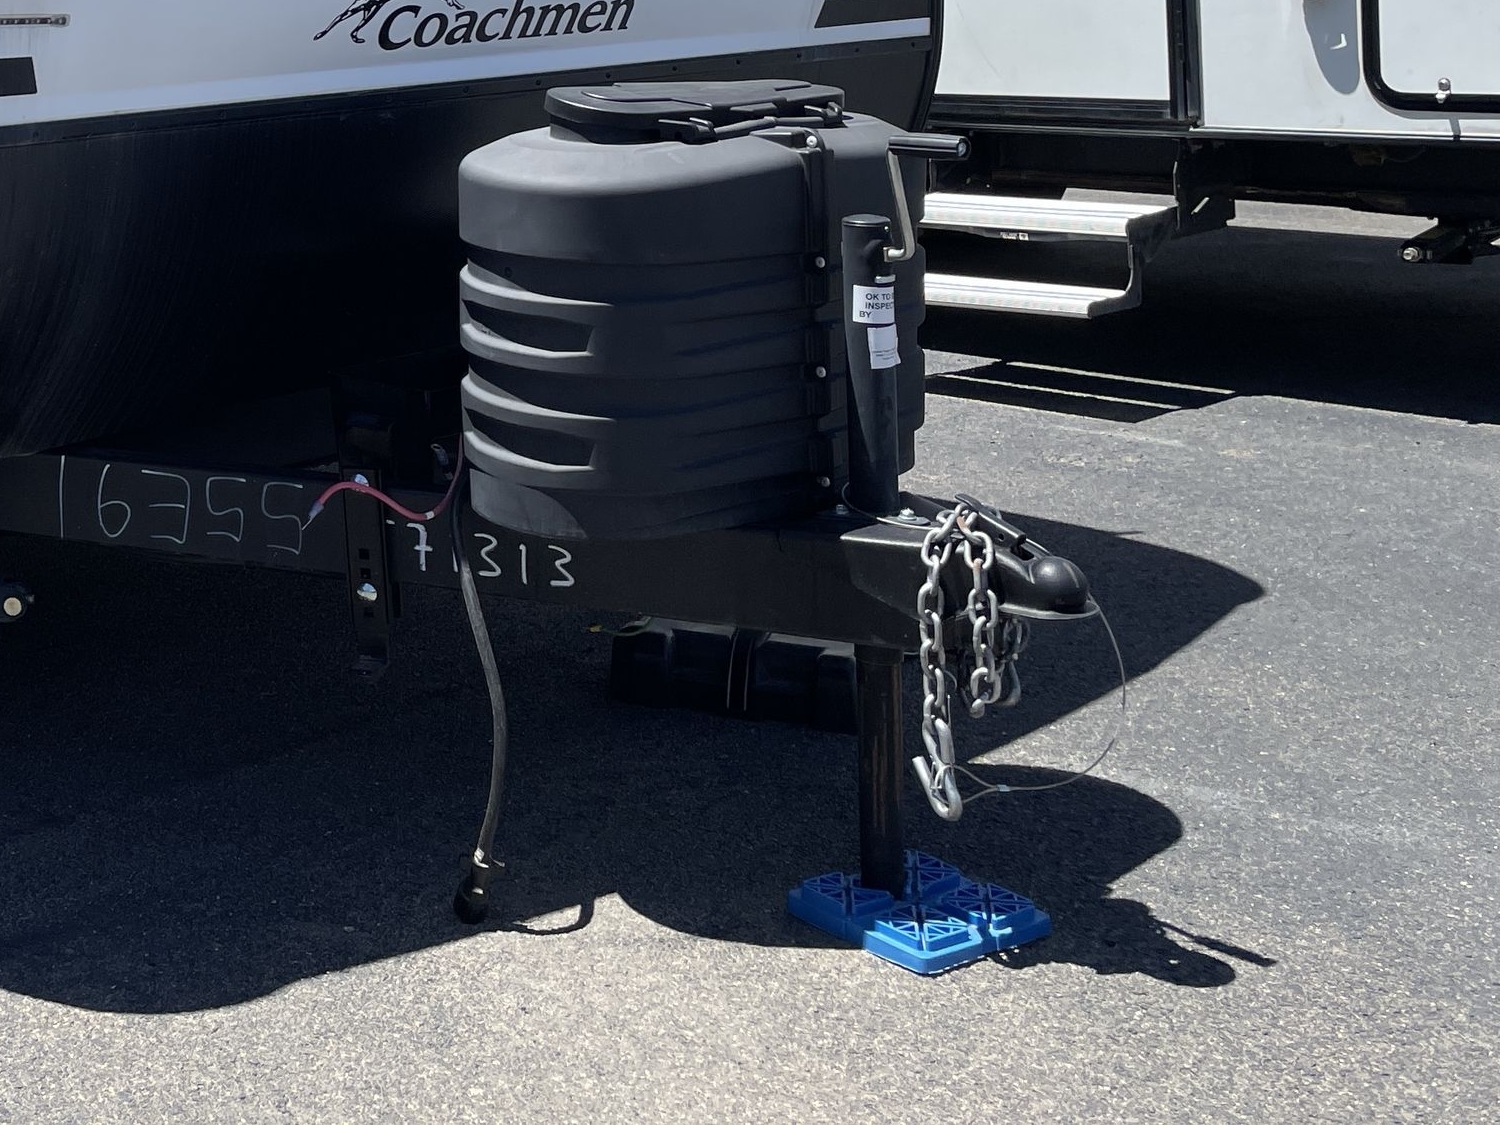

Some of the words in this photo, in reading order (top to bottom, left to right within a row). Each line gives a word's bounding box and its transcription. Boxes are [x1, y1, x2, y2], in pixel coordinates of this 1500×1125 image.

[865, 293, 879, 301] OK
[881, 293, 891, 301] TO
[859, 310, 872, 318] BY
[58, 454, 304, 556] 16355
